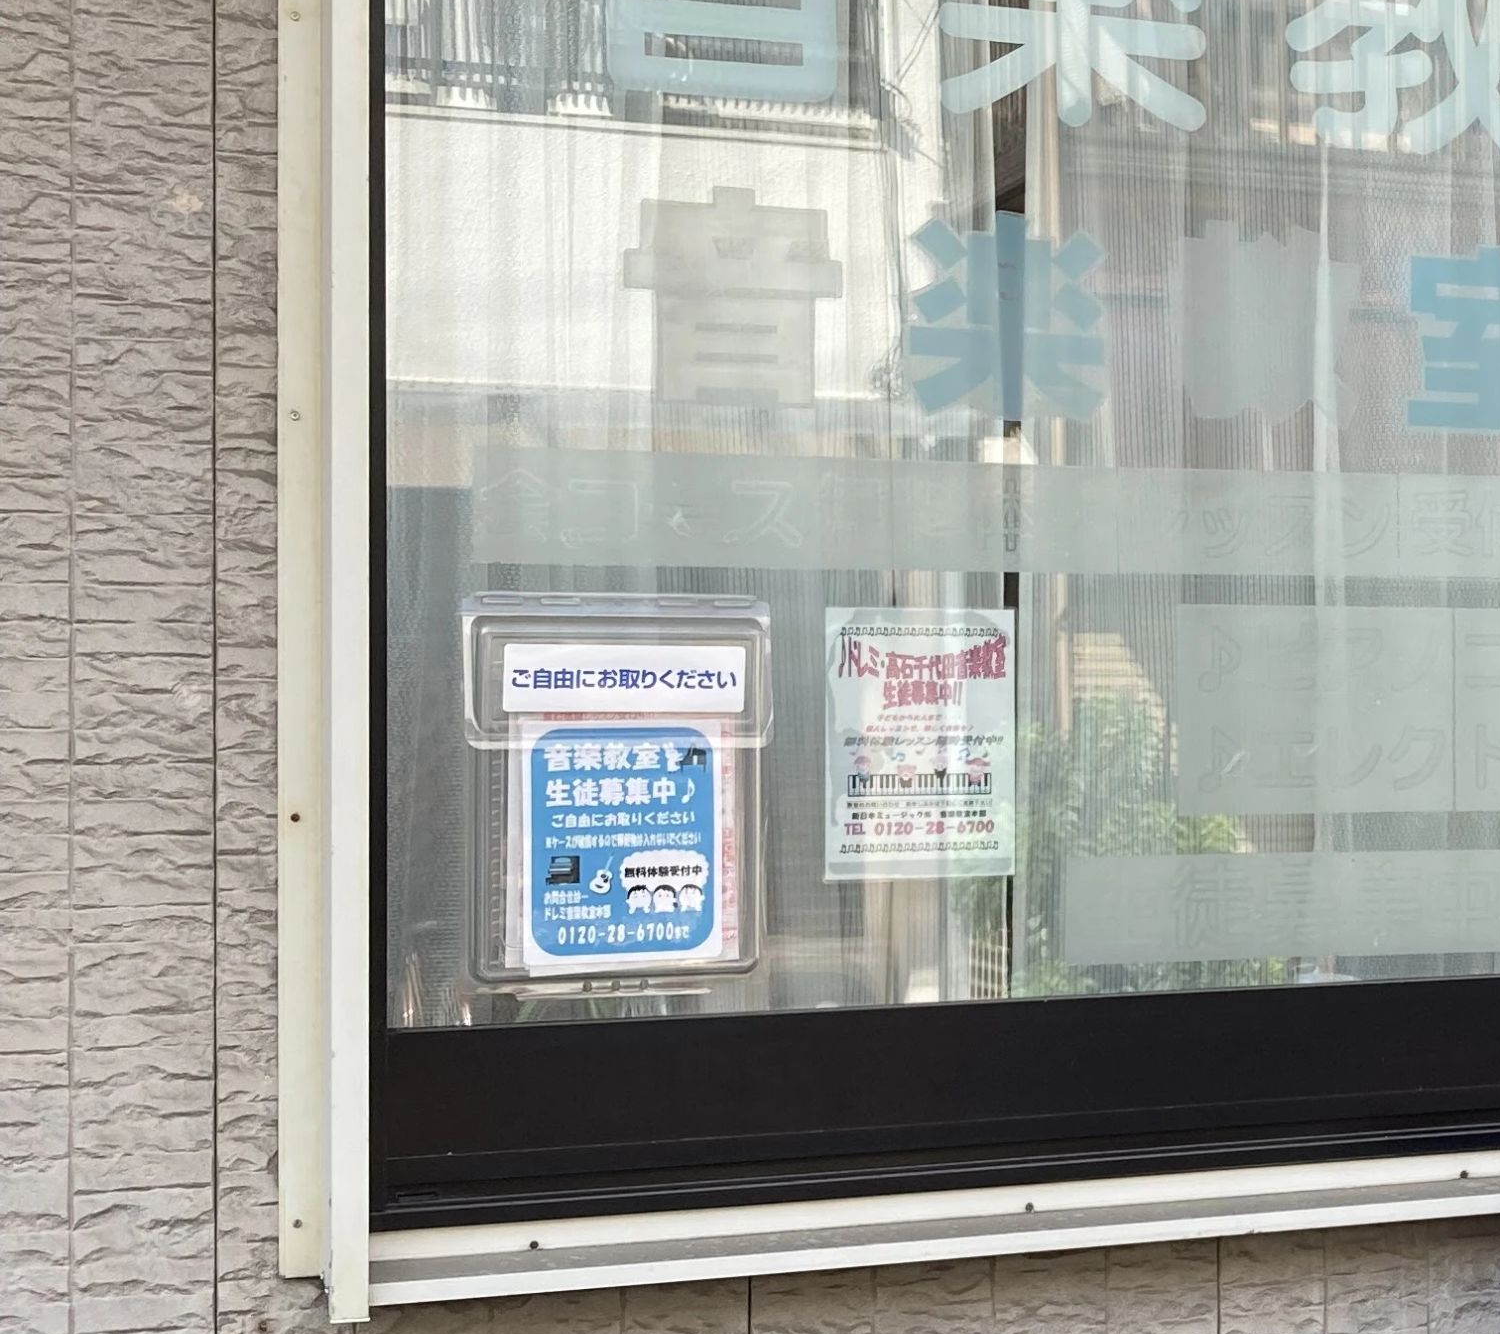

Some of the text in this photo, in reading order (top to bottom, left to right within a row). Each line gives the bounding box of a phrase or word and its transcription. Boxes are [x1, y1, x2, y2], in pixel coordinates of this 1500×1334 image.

[510, 667, 738, 691] ご自由にお取りください
[543, 741, 662, 773] 音楽教室
[545, 777, 677, 808] 生徒募集中
[550, 811, 696, 829] ご自由にお取りください
[843, 819, 996, 836] TEL 0120-28-6700
[623, 864, 704, 879] 無料体験受付中
